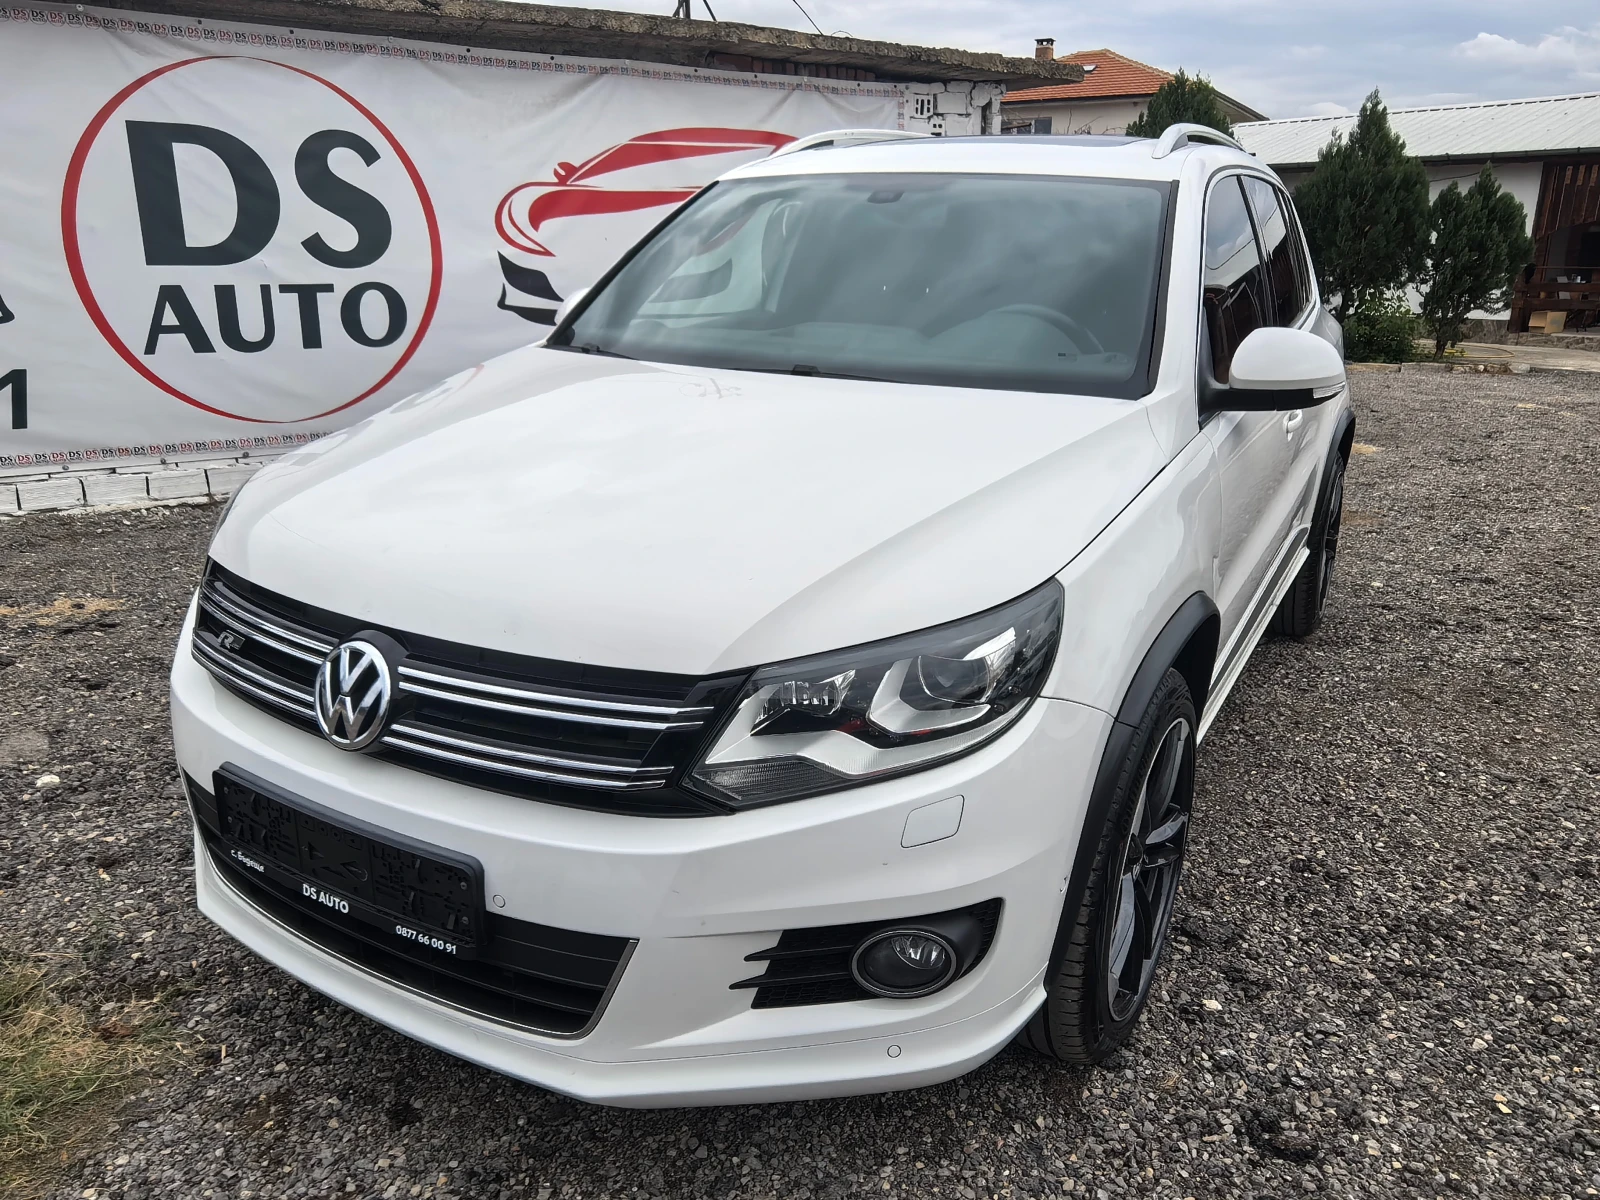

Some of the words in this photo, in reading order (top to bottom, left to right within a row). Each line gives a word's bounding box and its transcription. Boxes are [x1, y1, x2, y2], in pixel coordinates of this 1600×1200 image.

[31, 10, 44, 18] DS
[125, 119, 392, 269] DS
[144, 281, 408, 355] AUTO
[302, 883, 317, 900] DS
[319, 891, 350, 914] AUTO
[395, 925, 416, 941] 0877
[418, 933, 430, 946] 66
[431, 938, 443, 950] 00
[445, 943, 457, 955] 91
